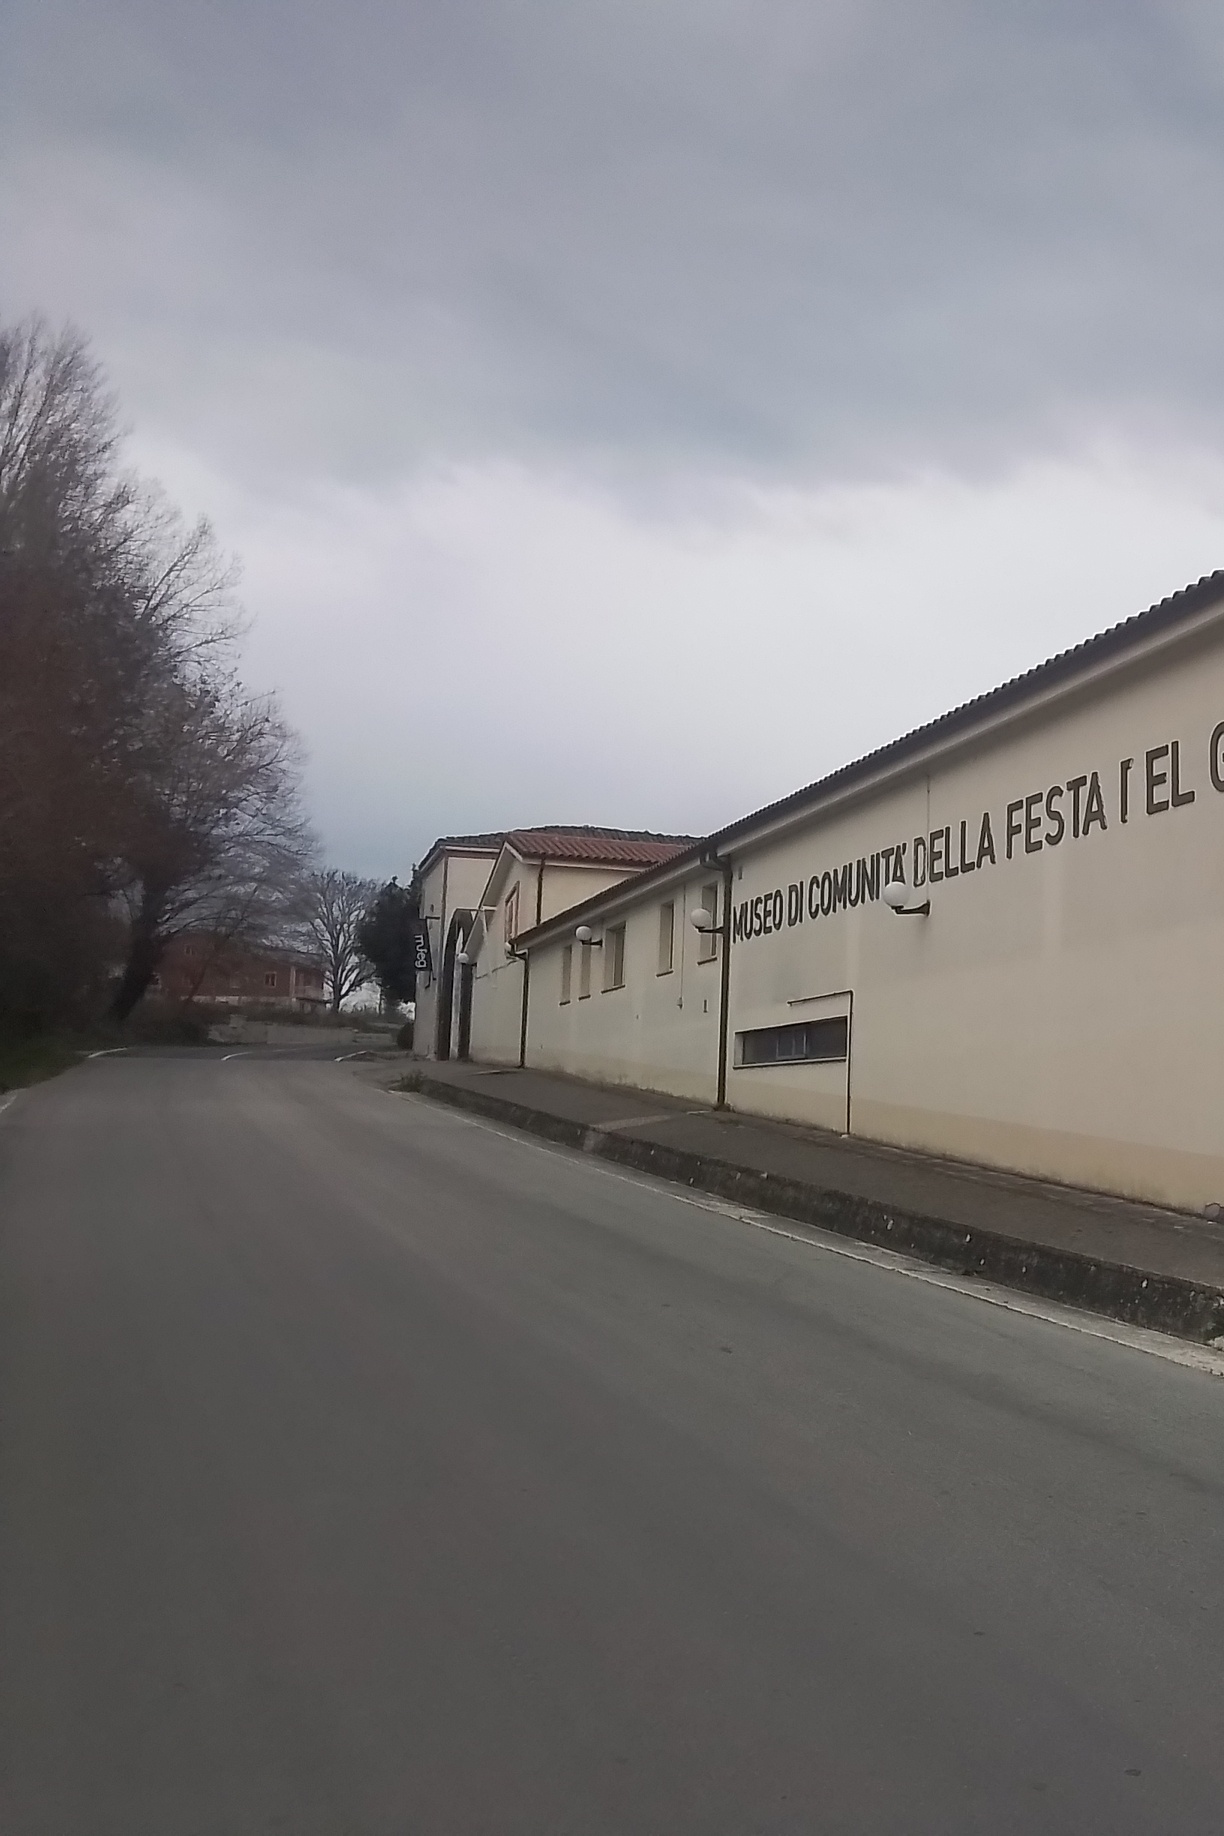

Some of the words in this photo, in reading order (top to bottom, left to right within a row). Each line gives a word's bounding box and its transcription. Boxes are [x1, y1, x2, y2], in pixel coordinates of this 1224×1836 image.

[733, 889, 783, 944] MUSEO
[787, 881, 804, 927] DI
[913, 812, 996, 887] DELLA
[1006, 771, 1107, 859] FESTA
